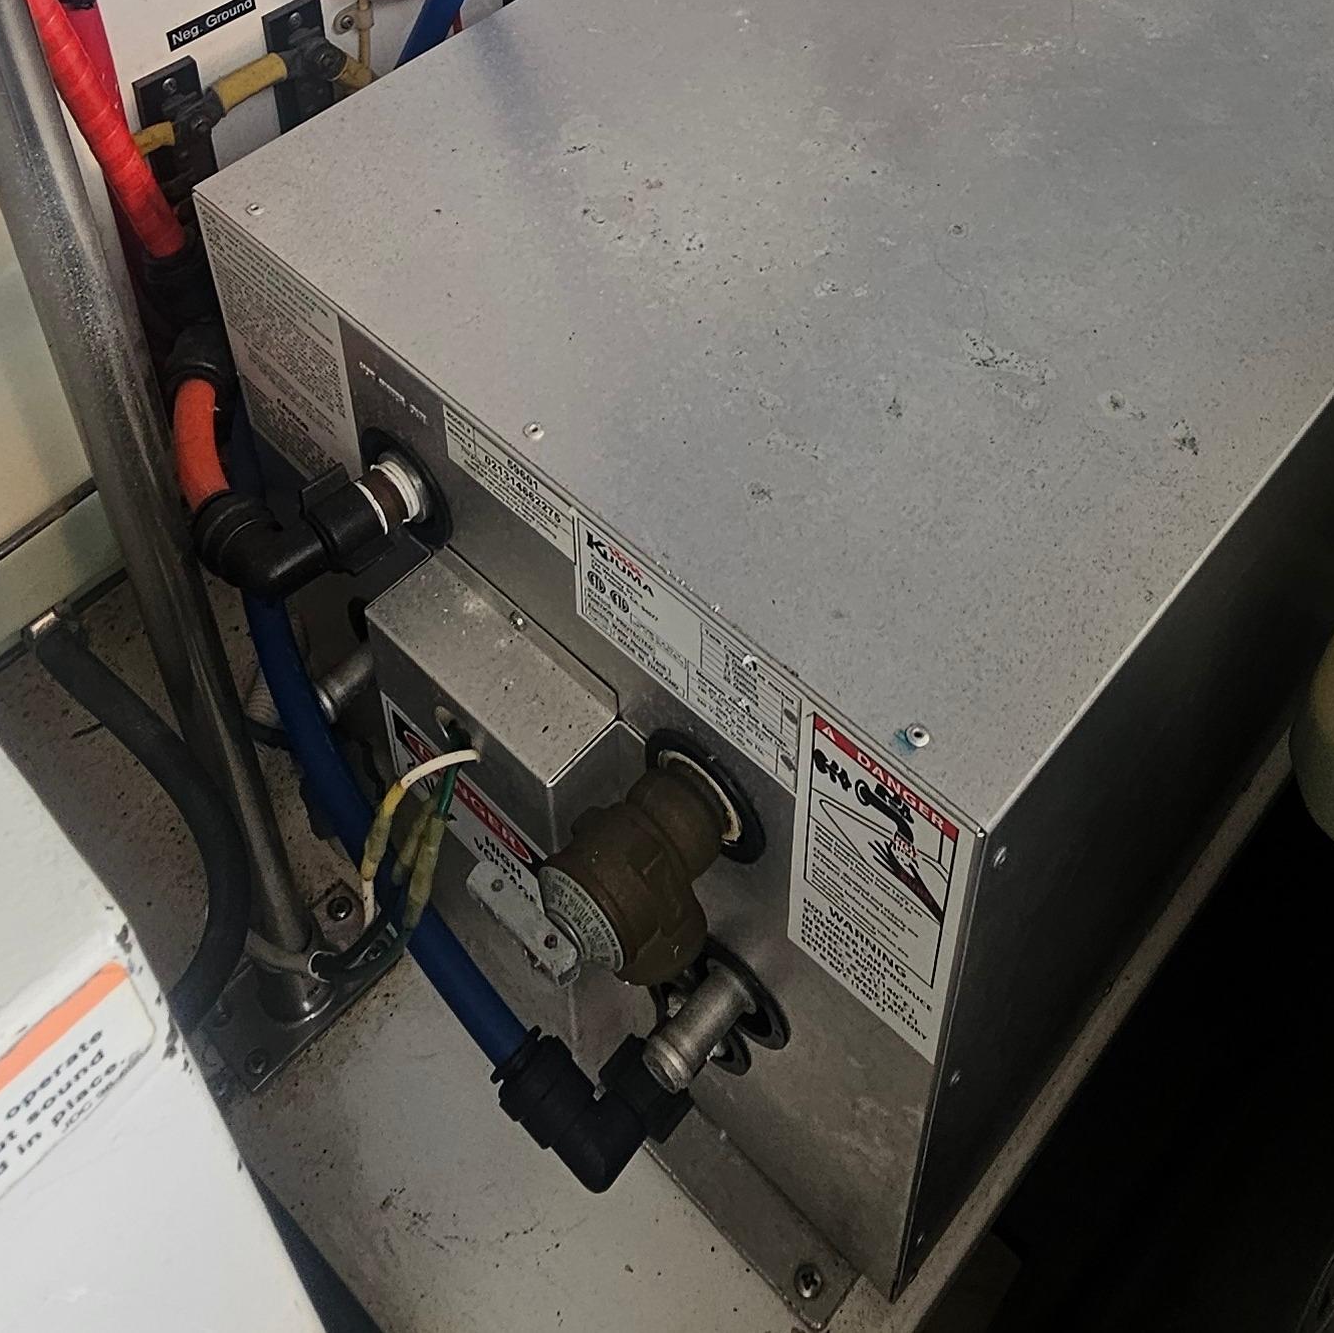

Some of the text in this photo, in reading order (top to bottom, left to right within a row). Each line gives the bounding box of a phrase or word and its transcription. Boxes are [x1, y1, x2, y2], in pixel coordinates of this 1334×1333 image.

[171, 25, 204, 46] Neg.
[586, 529, 654, 598] KUUMA
[855, 749, 946, 831] DANGER
[484, 835, 522, 880] HIGH
[802, 896, 933, 1013] HOT WATER CAN PRODUCE
[827, 905, 907, 979] WARNING
[4, 1030, 103, 1121] operate
[16, 1130, 43, 1155] in
[51, 1058, 126, 1128] place.
[26, 1048, 105, 1126] sound
